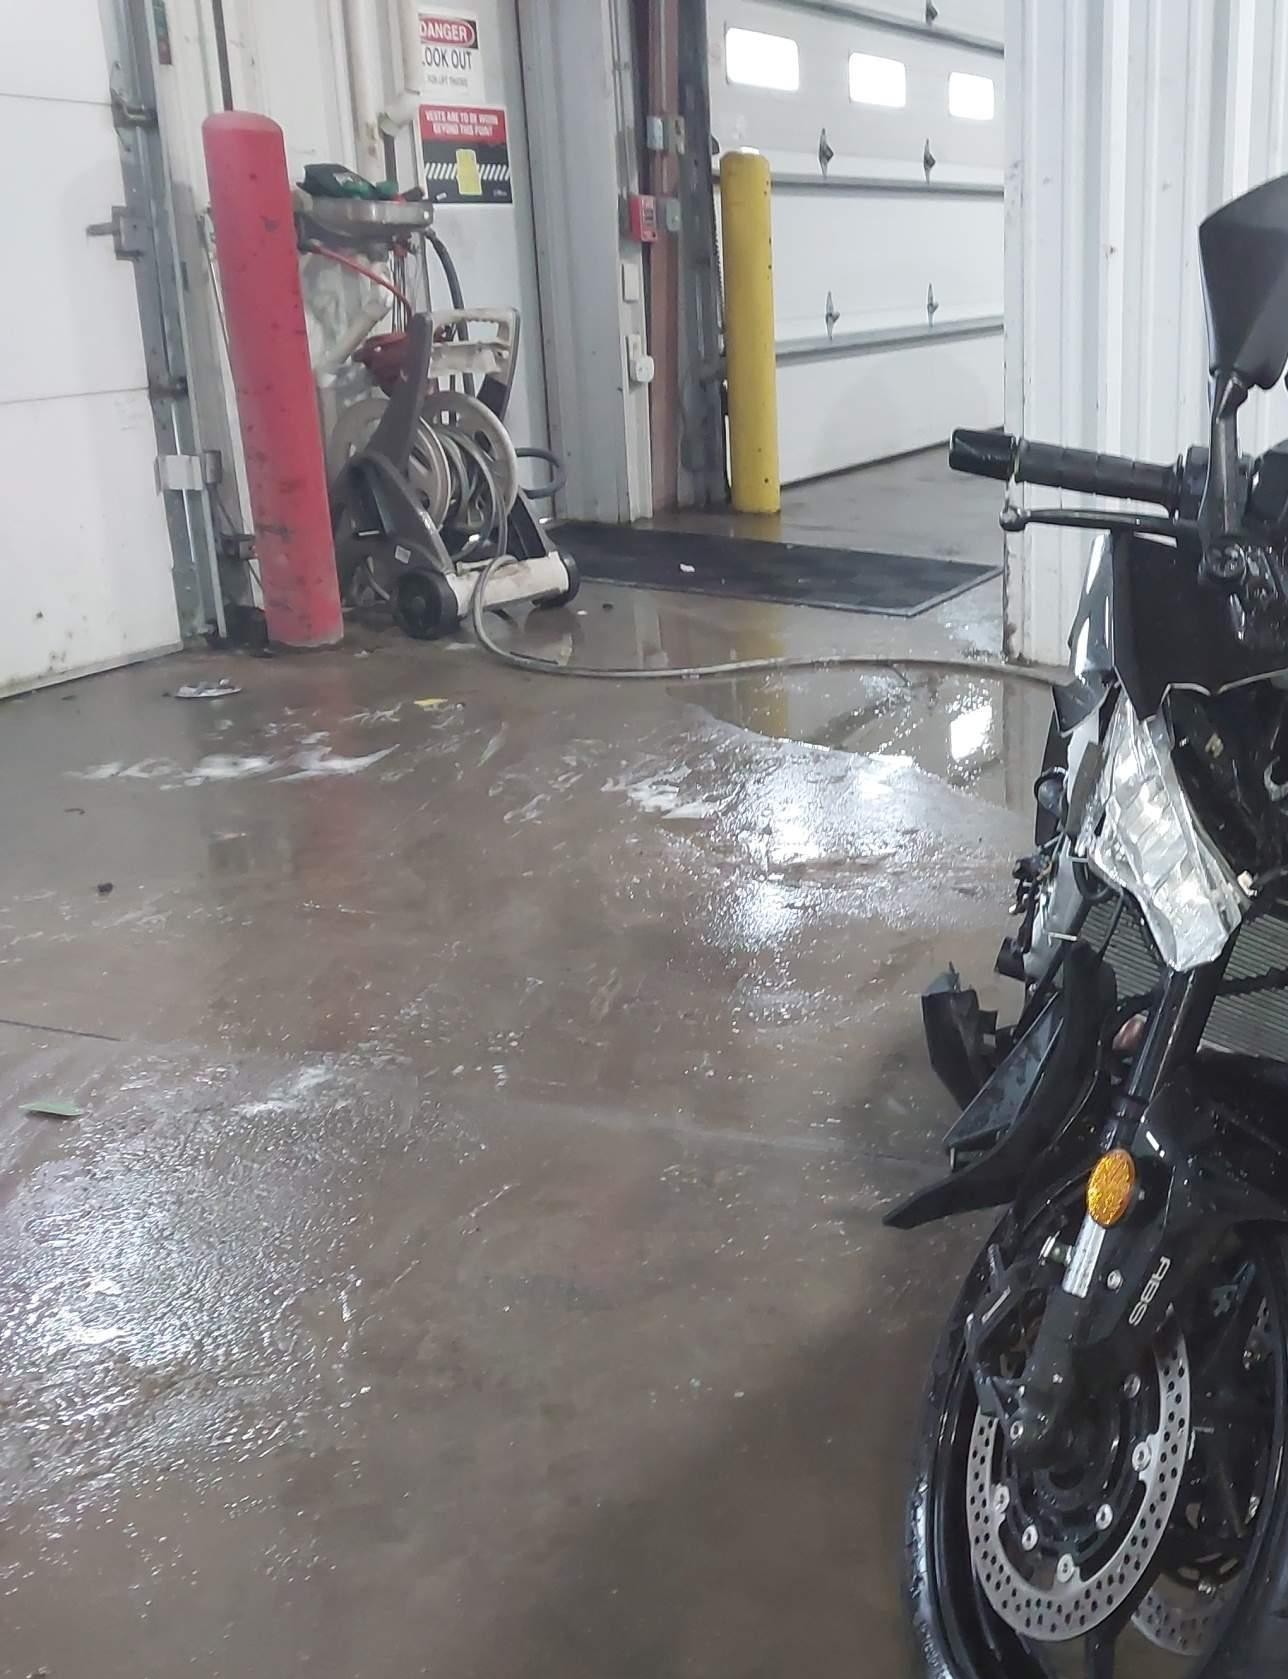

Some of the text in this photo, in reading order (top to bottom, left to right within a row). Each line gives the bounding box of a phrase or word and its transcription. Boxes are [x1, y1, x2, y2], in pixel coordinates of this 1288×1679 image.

[420, 21, 468, 42] DANGER
[422, 47, 471, 70] OOK OUT
[460, 112, 469, 123] TO
[1128, 1255, 1171, 1327] ABS
